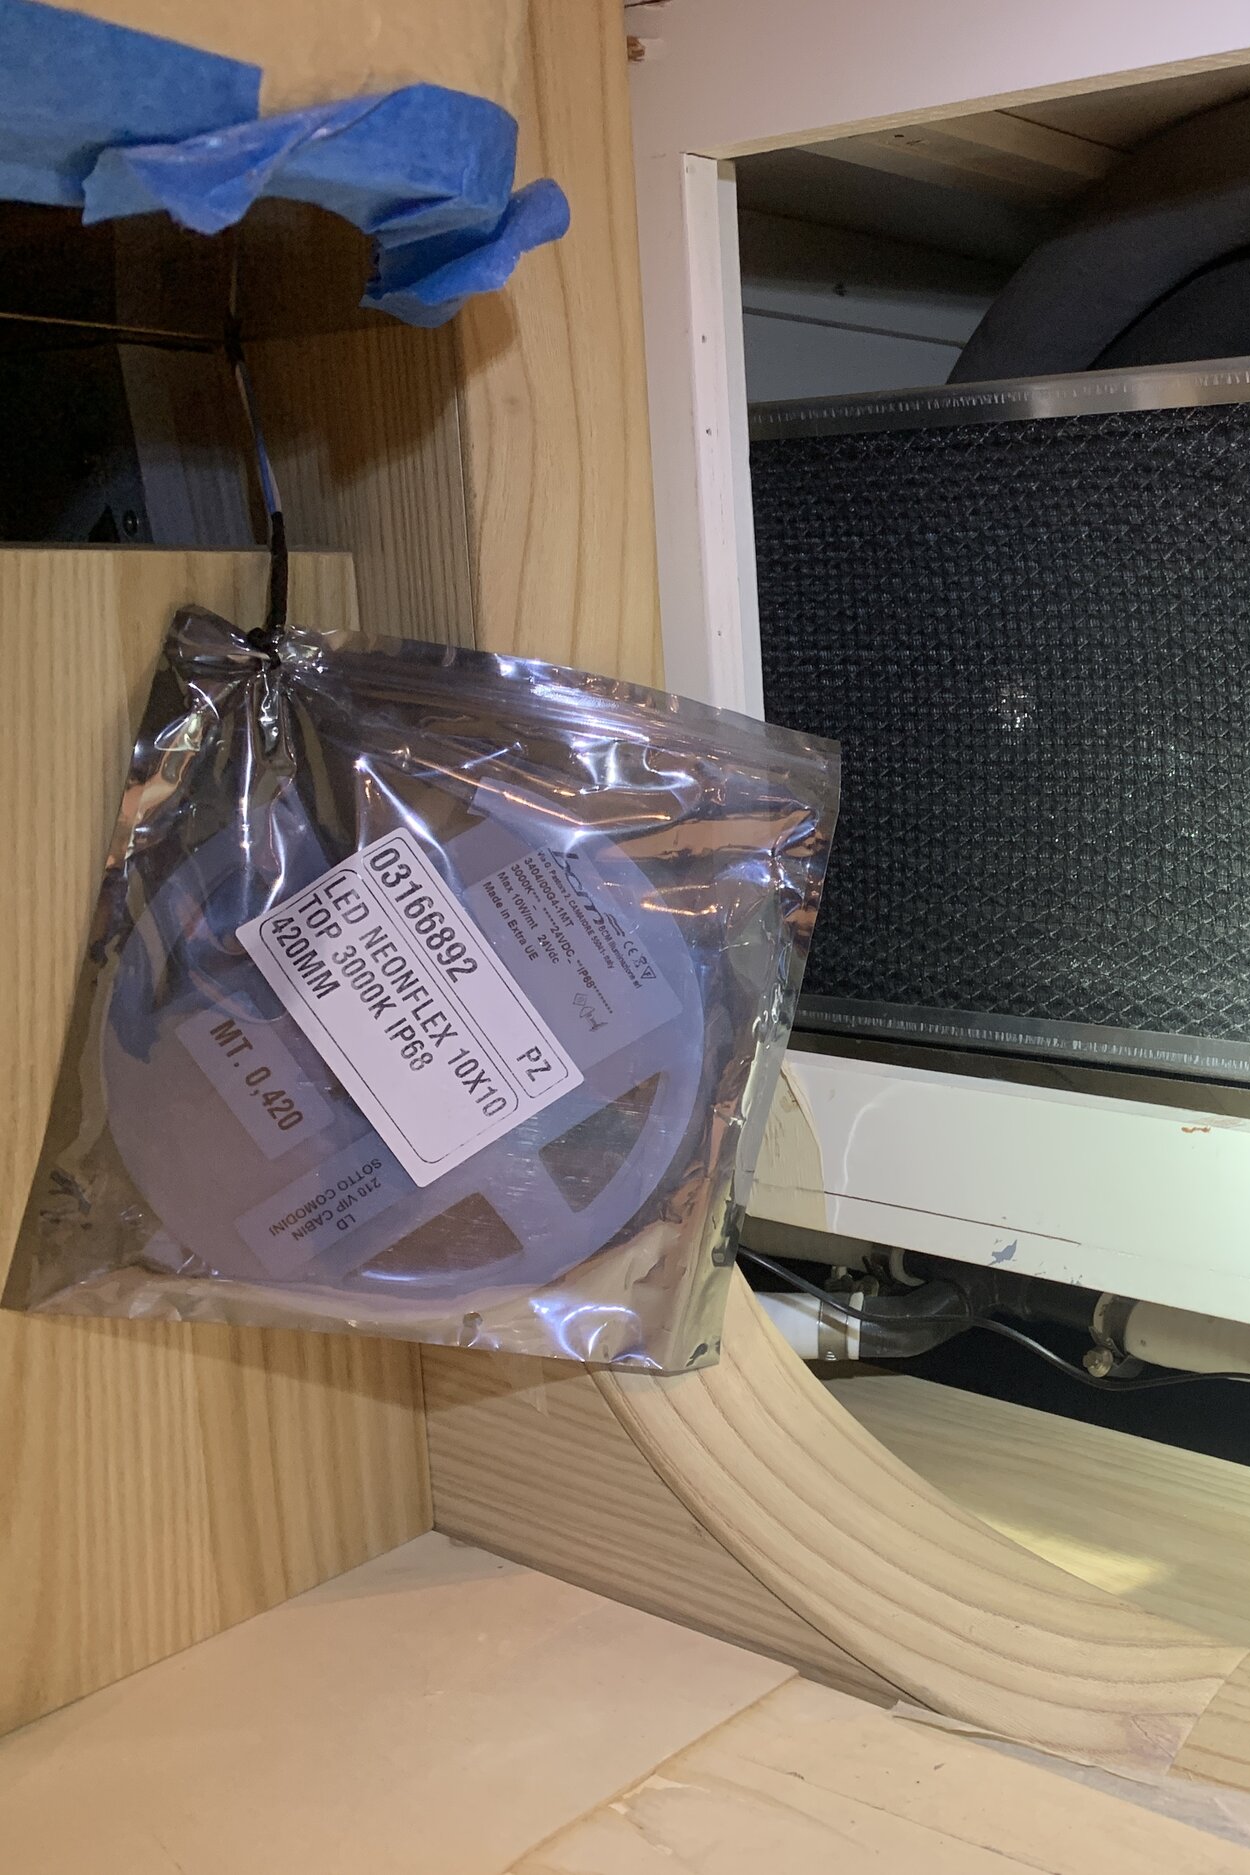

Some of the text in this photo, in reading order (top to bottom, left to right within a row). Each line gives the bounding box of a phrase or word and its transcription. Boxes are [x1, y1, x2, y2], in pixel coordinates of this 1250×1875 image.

[523, 857, 573, 928] 3404/00G4-1MT
[537, 851, 546, 862] Via
[267, 911, 340, 1000] 420MM
[482, 880, 538, 961] Made in Extra UE
[496, 871, 560, 964] Max 10W/mt 24Vdc
[597, 924, 611, 942] BCM
[294, 892, 435, 1073] TOP 3000K IP68
[322, 875, 508, 1118] LED NEONFLEX 10X10
[367, 845, 552, 1082] 03166892 PZ
[209, 1017, 304, 1132] MT. 0,420
[268, 1156, 382, 1236] SOTTO COMODINI
[291, 1176, 381, 1241] 210 VIP CABIN
[335, 1212, 356, 1231] LD
